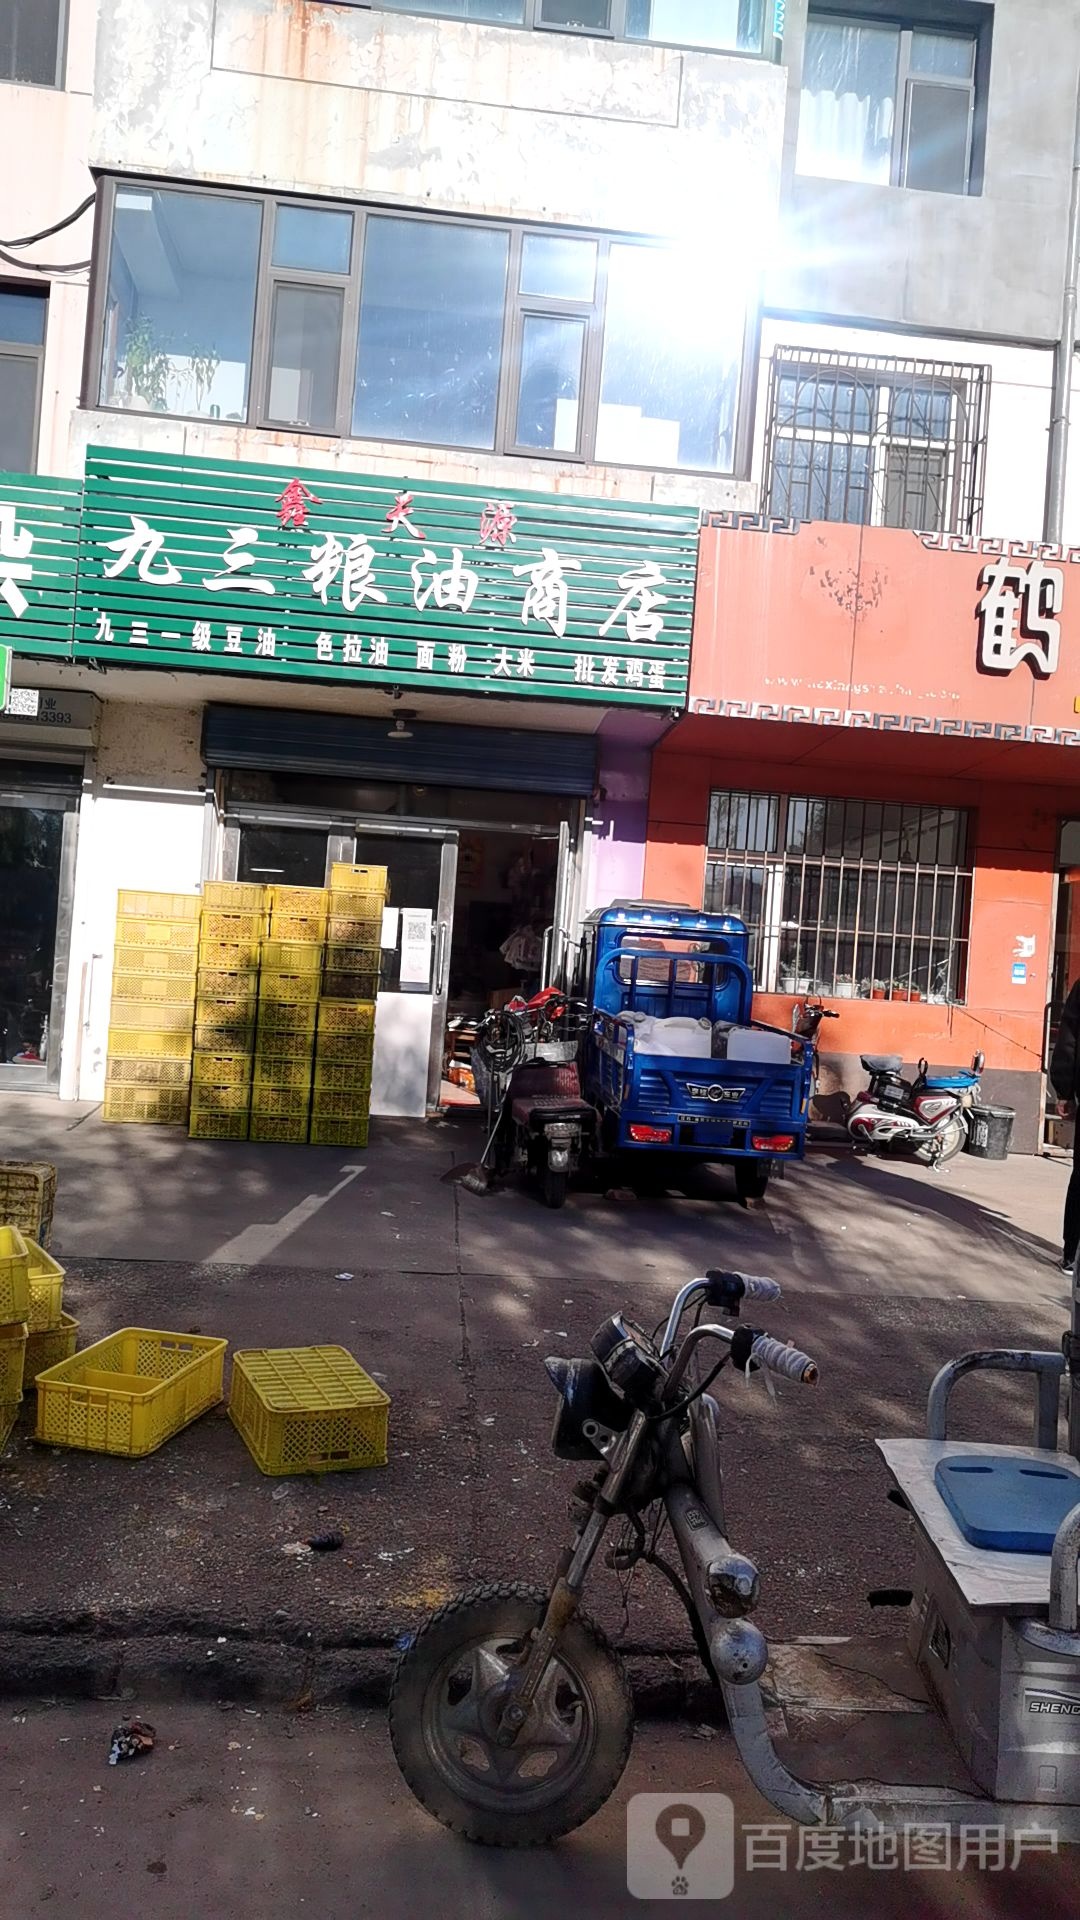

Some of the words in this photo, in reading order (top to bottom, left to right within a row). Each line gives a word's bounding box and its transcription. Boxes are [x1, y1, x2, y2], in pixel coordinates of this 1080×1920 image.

[104, 515, 668, 641] 九三粮油商店
[976, 557, 1064, 676] 鹤
[95, 612, 277, 657] 九三一级豆油
[315, 632, 389, 666] 色拉油
[417, 641, 467, 673] 面粉
[494, 648, 535, 678] 大米
[575, 656, 667, 690] 批发鸡蛋
